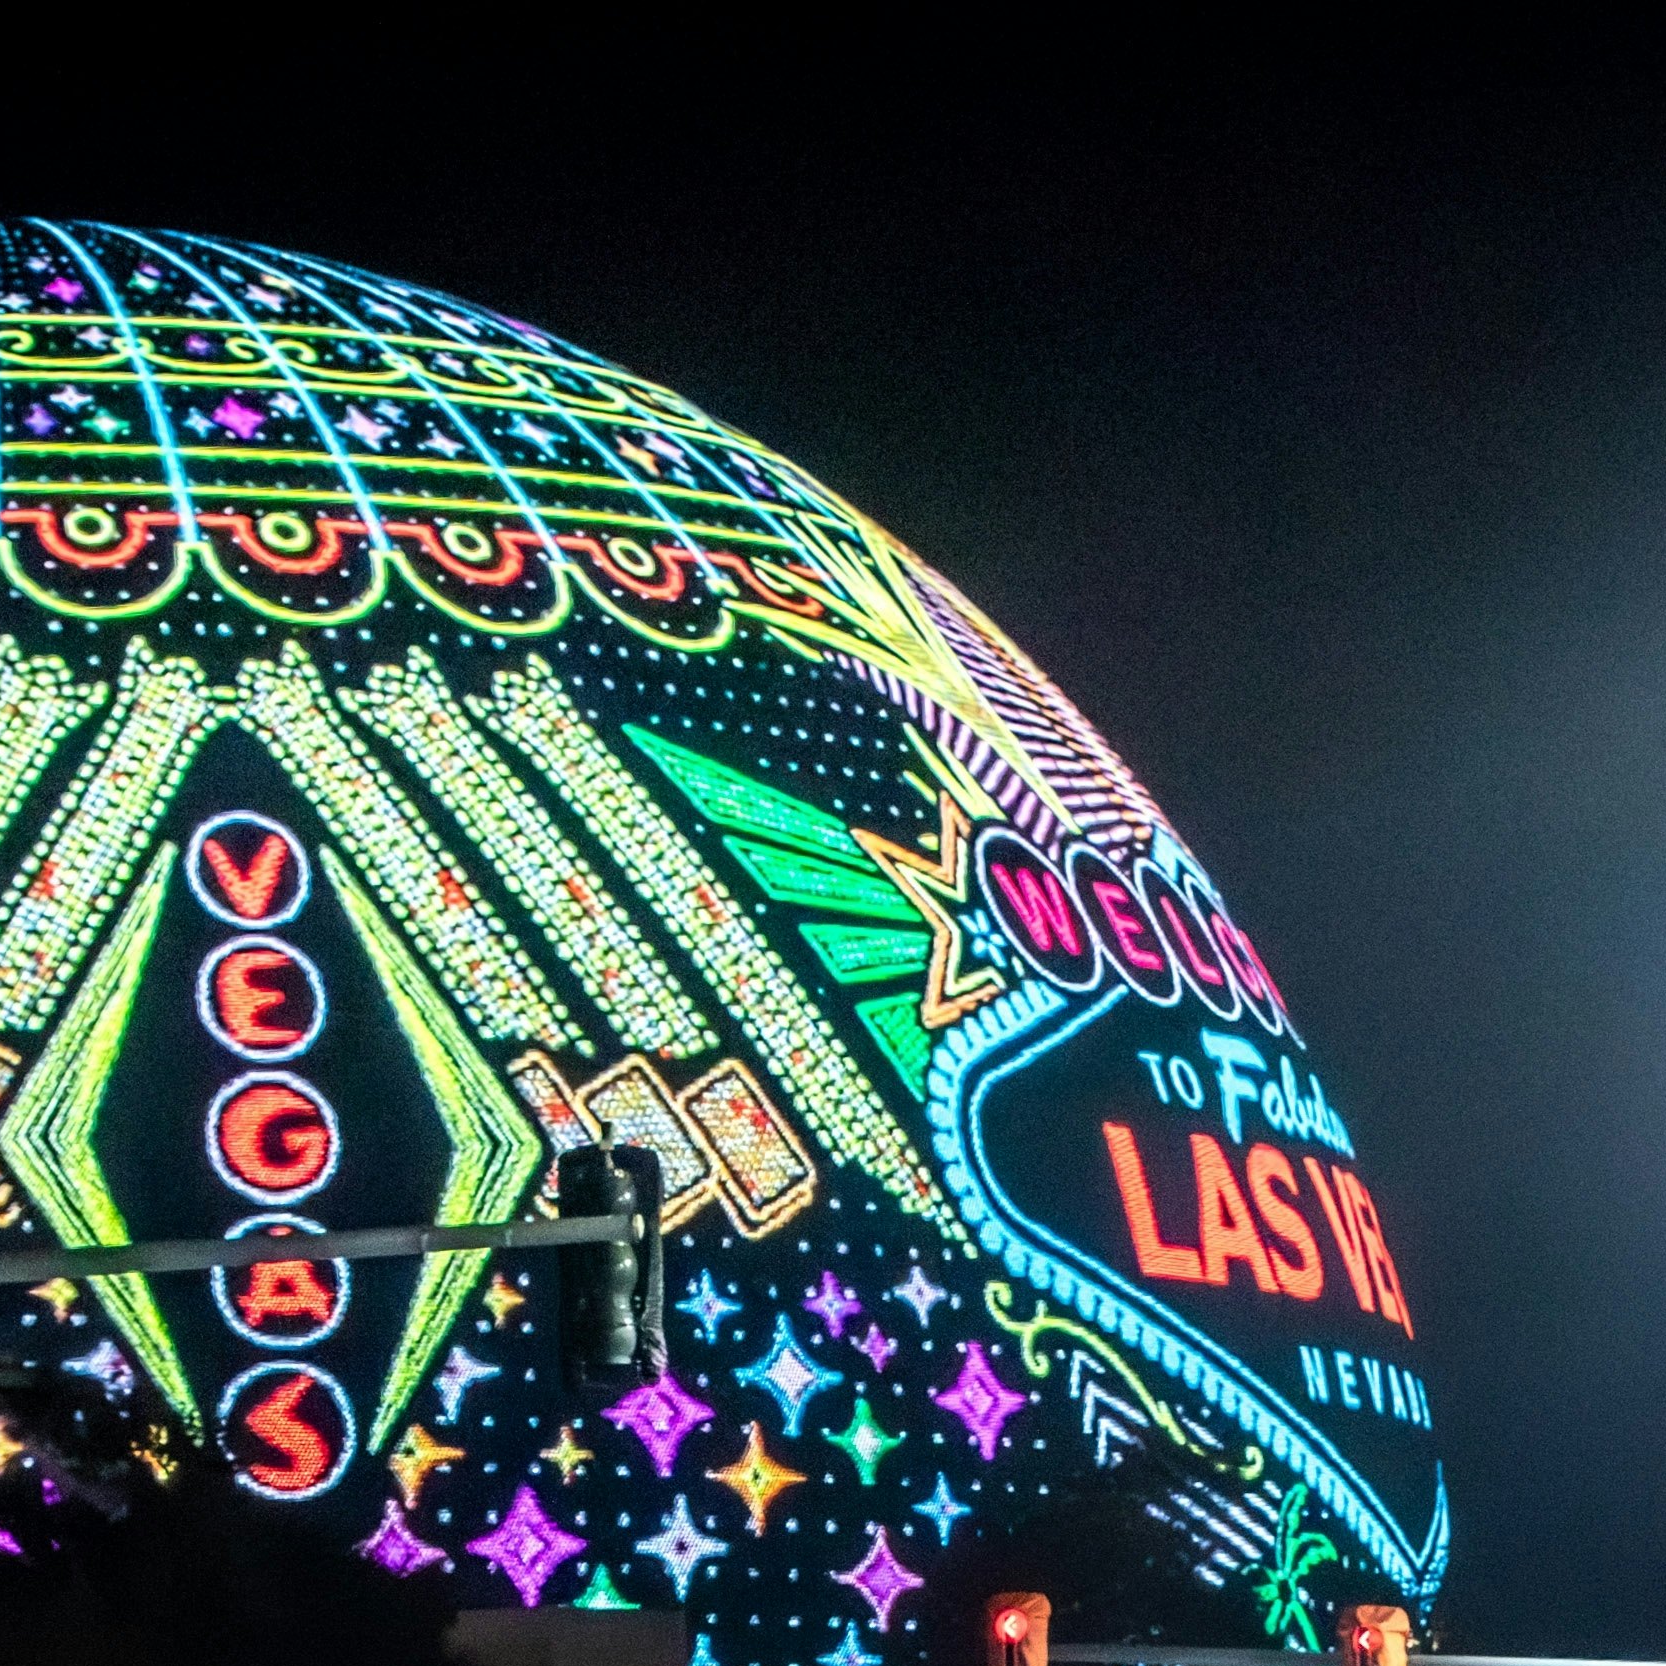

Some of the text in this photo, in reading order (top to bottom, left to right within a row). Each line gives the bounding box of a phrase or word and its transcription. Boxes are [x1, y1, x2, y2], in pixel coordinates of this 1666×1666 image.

[202, 833, 336, 1493] VEGAS
[1138, 1051, 1204, 1110] TO
[1102, 1121, 1324, 1301] LAS
